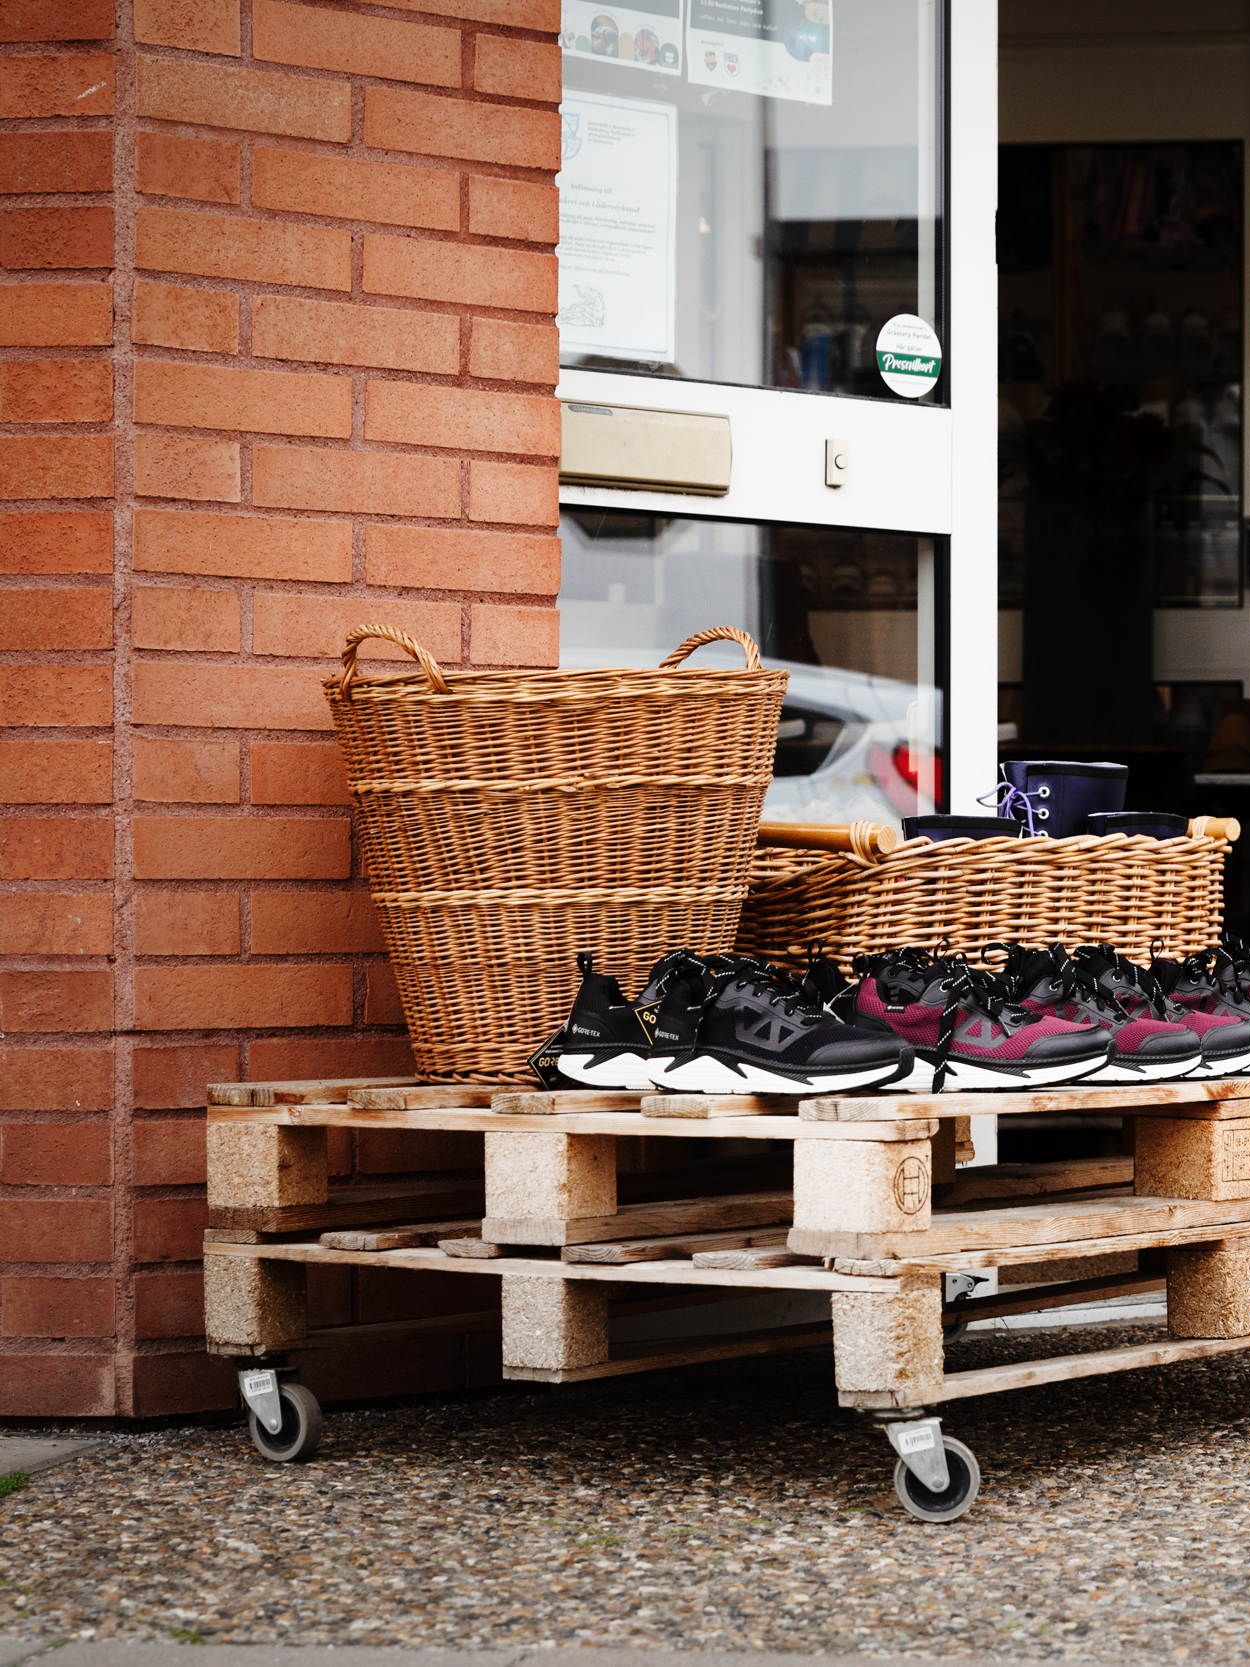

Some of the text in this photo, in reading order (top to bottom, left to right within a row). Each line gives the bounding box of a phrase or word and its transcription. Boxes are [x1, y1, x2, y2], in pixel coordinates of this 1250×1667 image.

[570, 183, 614, 195] Inlämning till
[578, 199, 590, 207] och
[591, 200, 640, 214] Läderverkstad
[912, 332, 932, 340] Handel
[882, 353, 936, 374] Presentkort
[577, 1027, 601, 1038] GORE-TEX
